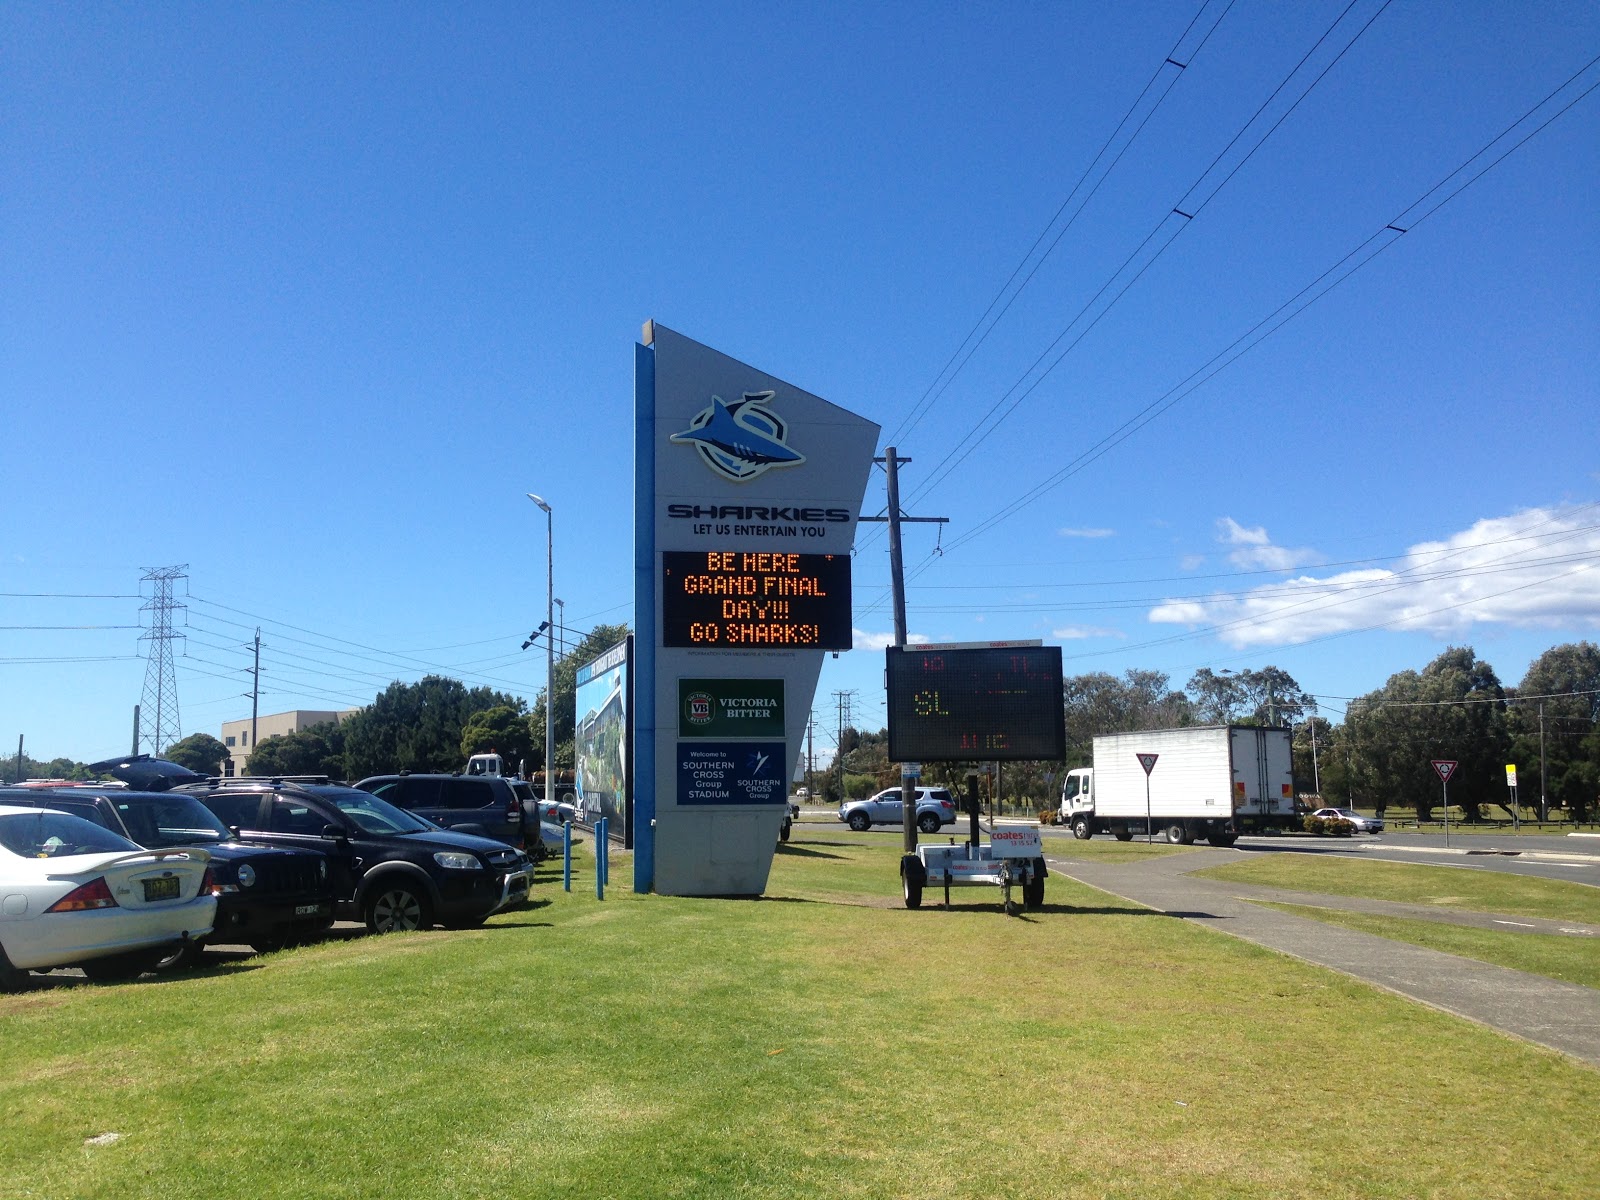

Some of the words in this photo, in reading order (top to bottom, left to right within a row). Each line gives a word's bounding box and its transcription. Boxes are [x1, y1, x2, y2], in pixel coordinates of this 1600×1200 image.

[668, 504, 850, 522] SHARKIES
[694, 524, 711, 535] LET
[716, 524, 730, 535] US
[734, 525, 797, 537] ENTERTAIN
[801, 526, 825, 537] YOU
[708, 552, 735, 572] BE
[743, 552, 800, 573] HERE
[684, 575, 756, 595] GRAND
[764, 576, 826, 596] FINAL
[722, 600, 789, 619] DAY!!!
[690, 623, 718, 642] GO
[726, 623, 819, 643] SHARKS!
[719, 698, 777, 707] VICTORIA
[693, 703, 708, 713] VB
[726, 709, 770, 718] BITTER
[683, 761, 735, 769] SOUTHERN
[693, 771, 724, 779] CROSS
[695, 780, 722, 789] Group
[688, 790, 729, 798] STADIUM
